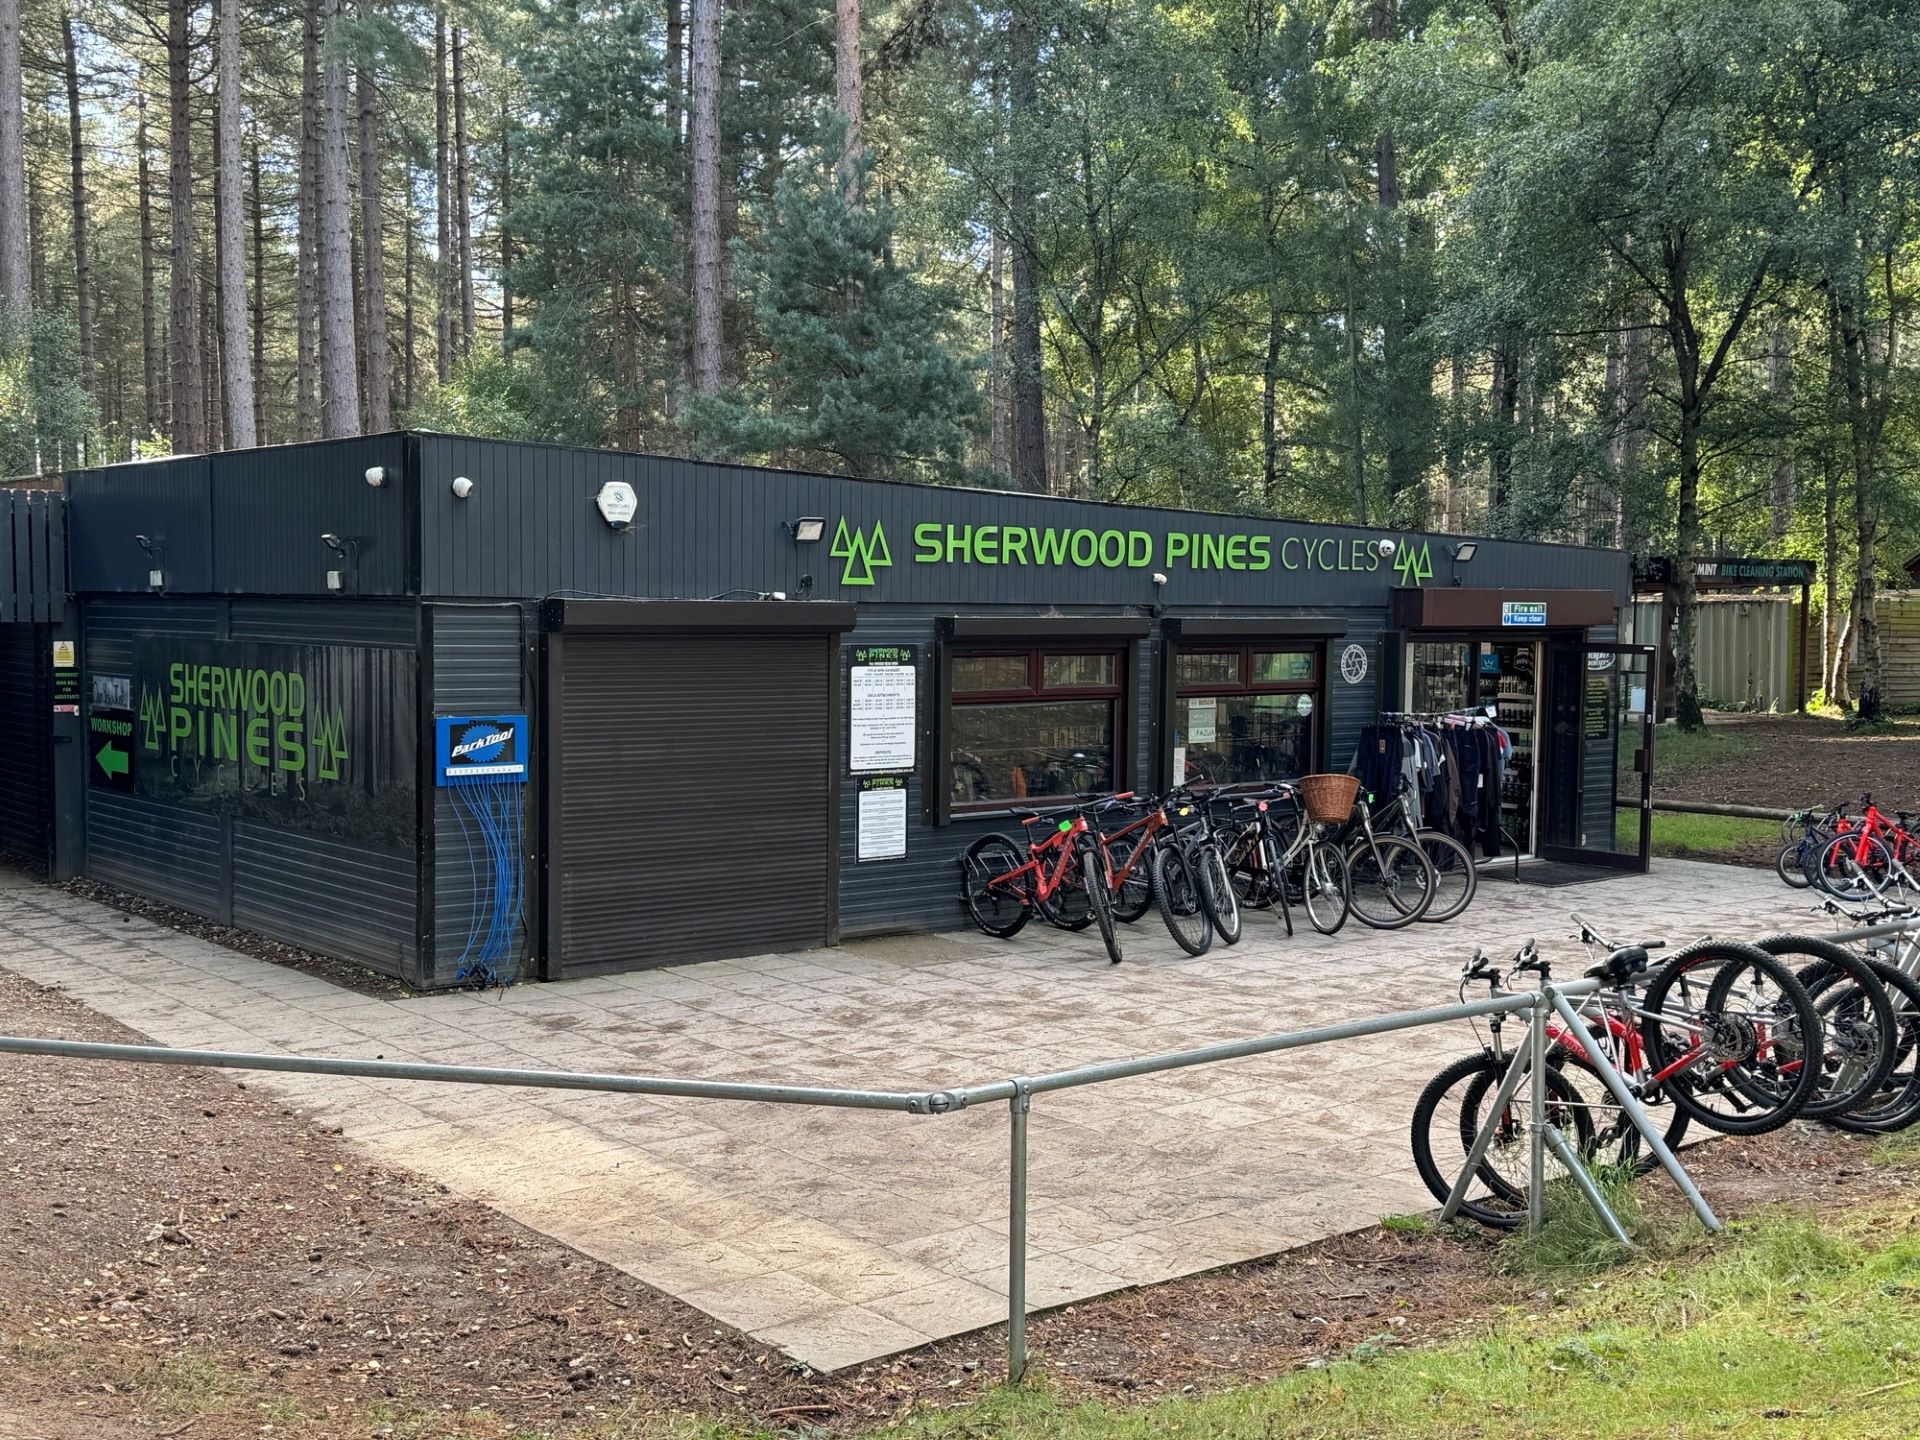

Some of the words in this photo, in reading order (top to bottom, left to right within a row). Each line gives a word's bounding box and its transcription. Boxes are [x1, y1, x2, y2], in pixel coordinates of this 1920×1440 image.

[914, 522, 1152, 568] SHERWOOD
[1165, 532, 1270, 572] PINES
[1281, 537, 1379, 572] CYCLES
[1697, 563, 1717, 576] MINT
[1721, 564, 1738, 577] BIKE
[1739, 565, 1775, 577] CLEANING
[1776, 566, 1804, 578] STATION
[1513, 615, 1527, 623] Keep
[1514, 604, 1528, 612] Fire
[1529, 604, 1543, 612] exit
[170, 662, 306, 717] SHERWOOD
[91, 717, 133, 737] WORKSHOP
[171, 707, 306, 771] PINES
[171, 755, 306, 801] CYCLES
